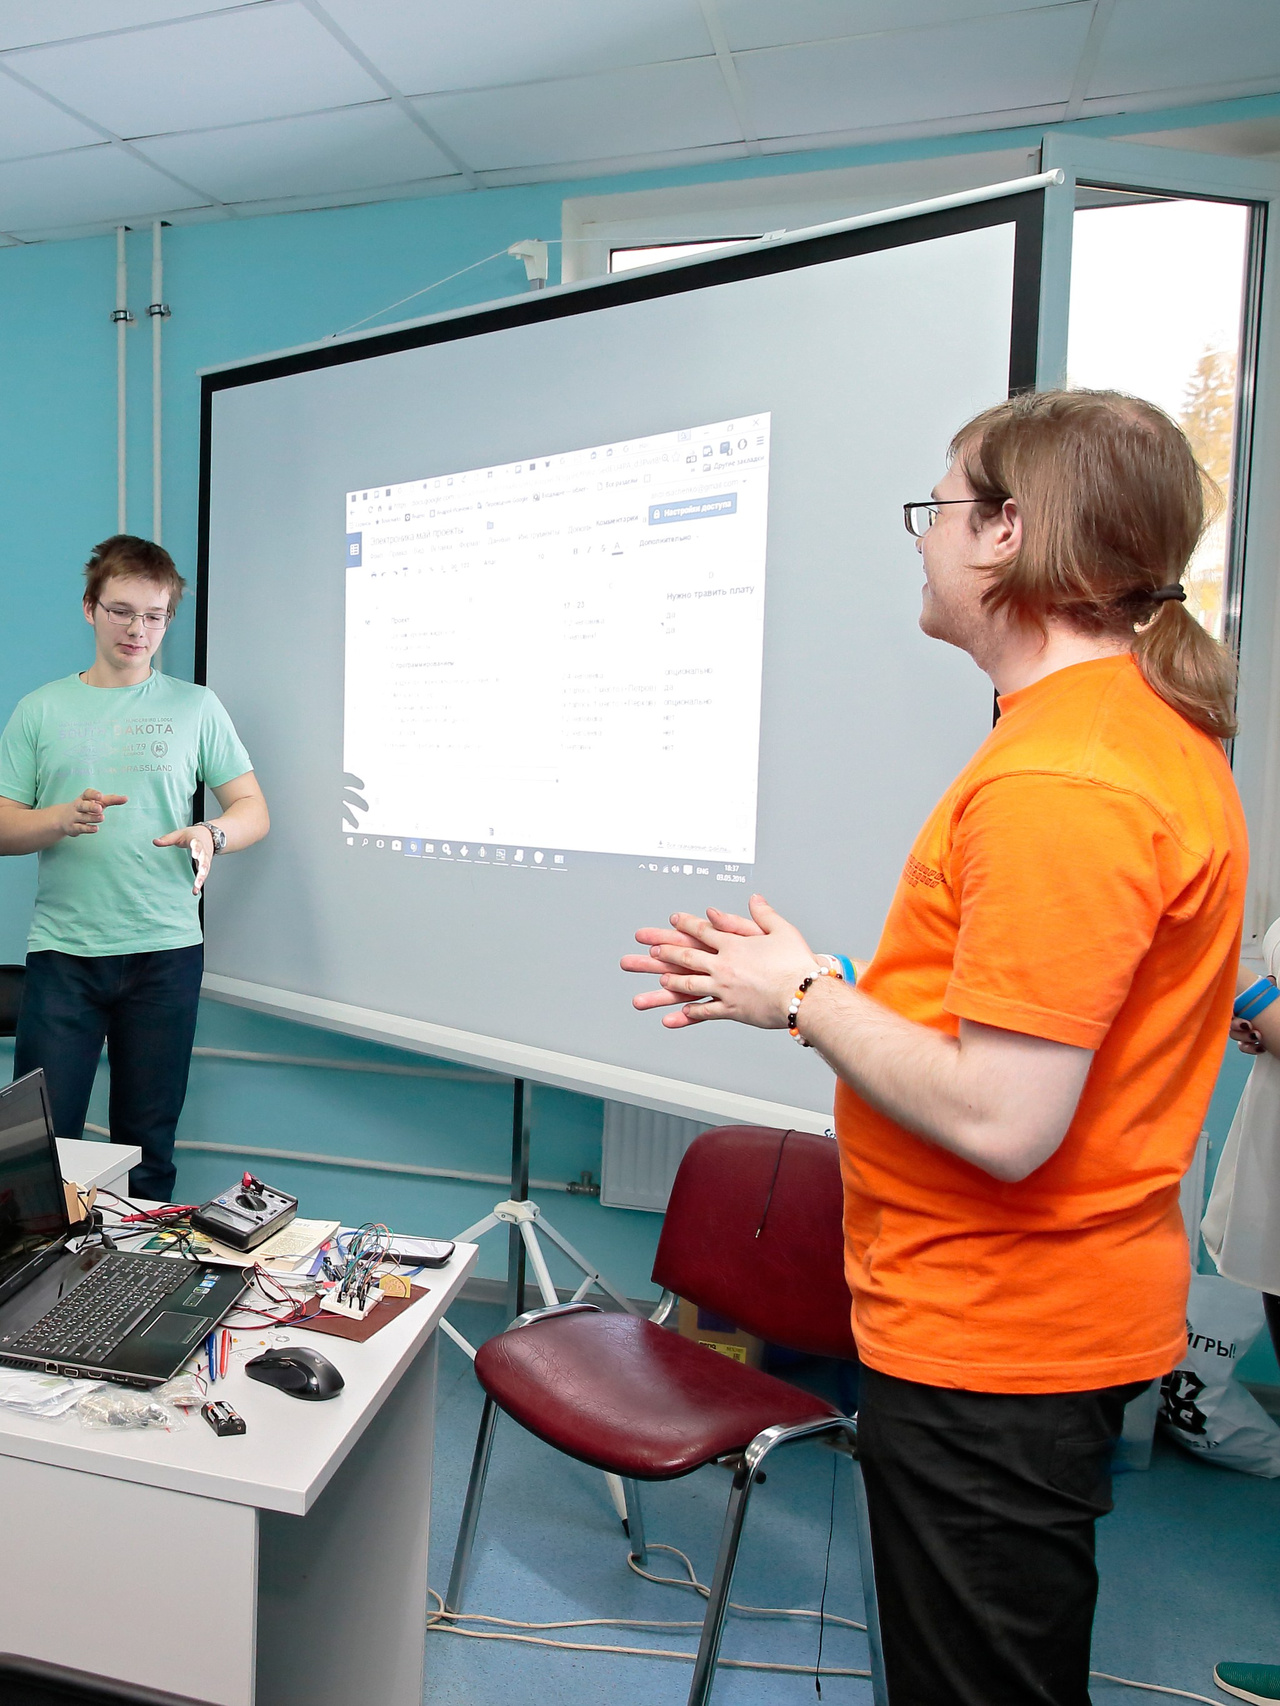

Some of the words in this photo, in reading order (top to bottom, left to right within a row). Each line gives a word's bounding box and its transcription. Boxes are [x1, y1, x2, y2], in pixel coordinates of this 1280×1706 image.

[663, 505, 700, 517] Настройки
[701, 501, 732, 512] доступа
[666, 592, 692, 602] Нужно
[694, 587, 728, 599] травить
[729, 584, 755, 595] плату
[113, 724, 174, 737] DAKOTA
[696, 867, 709, 875] ENG
